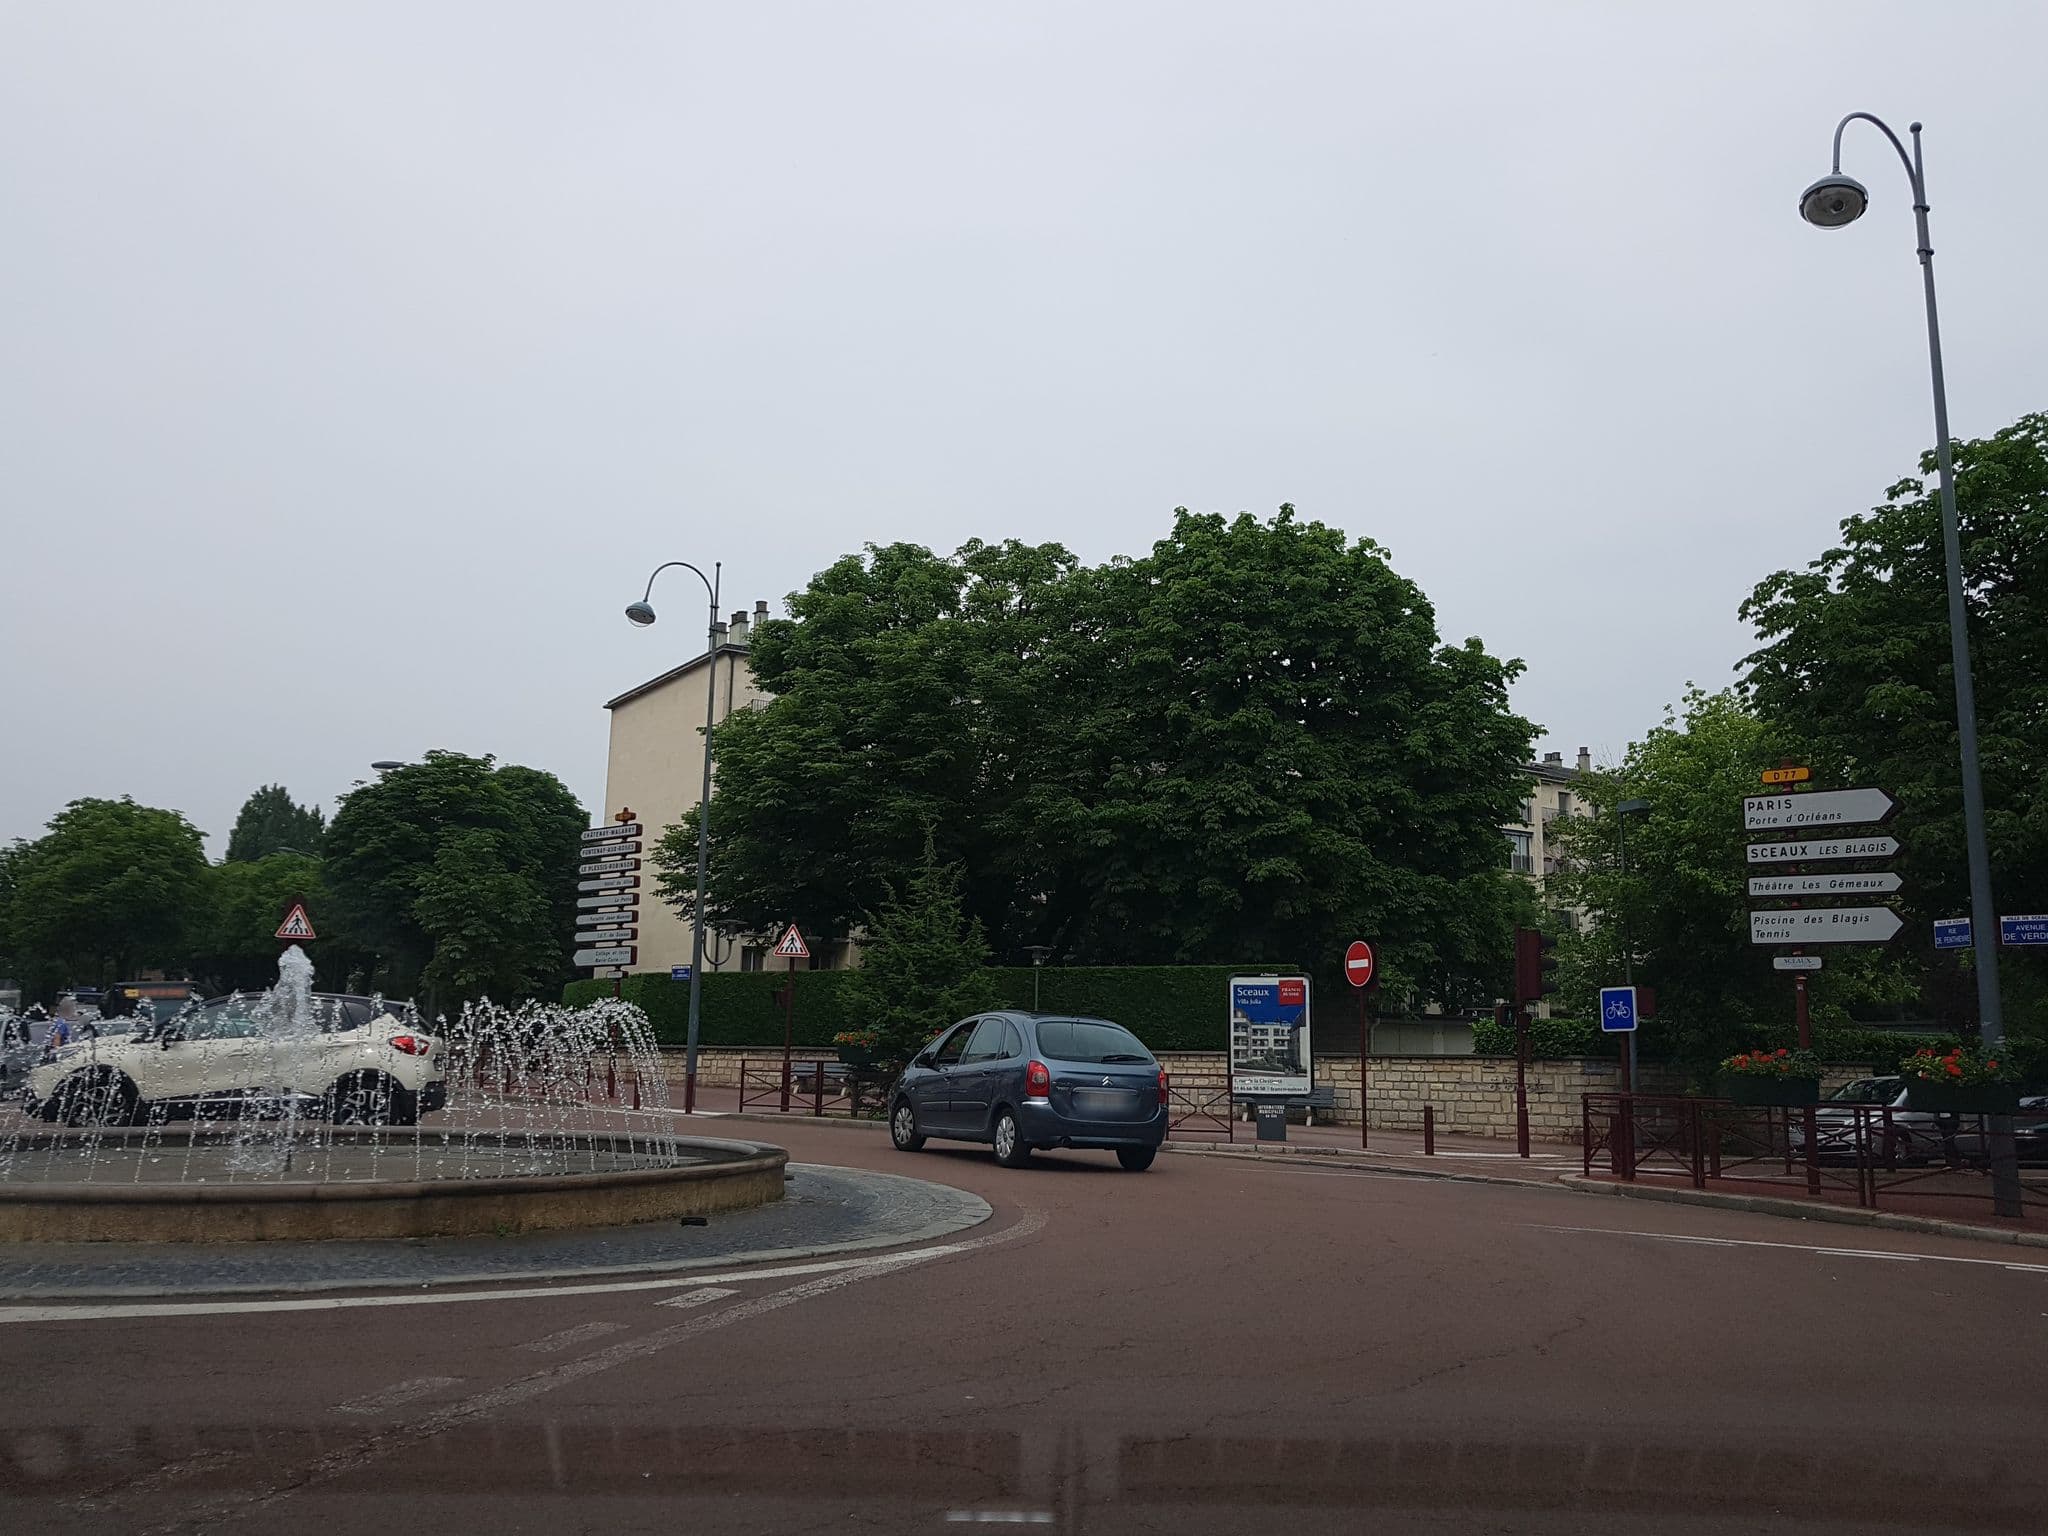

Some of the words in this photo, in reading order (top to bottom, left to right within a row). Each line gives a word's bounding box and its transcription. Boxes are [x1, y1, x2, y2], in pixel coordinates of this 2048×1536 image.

[1773, 772, 1780, 780] D
[1783, 771, 1797, 779] 77
[1747, 799, 1793, 812] PARIS
[1748, 816, 1778, 826] Porte
[1786, 812, 1842, 823] d'Orléans
[1750, 845, 1808, 859] SCEAUX
[1819, 845, 1838, 855] LES
[1845, 842, 1887, 854] BLAGIS
[1753, 881, 1794, 891] Théâtre
[1802, 880, 1820, 890] Les
[1829, 878, 1884, 889] Gémeaux
[1753, 915, 1795, 925] Piscine
[1803, 914, 1823, 924] des
[1832, 913, 1870, 925] Blagis
[1755, 929, 1791, 939] Tennis
[2004, 932, 2017, 941] DE
[1237, 987, 1270, 997] Sceaux
